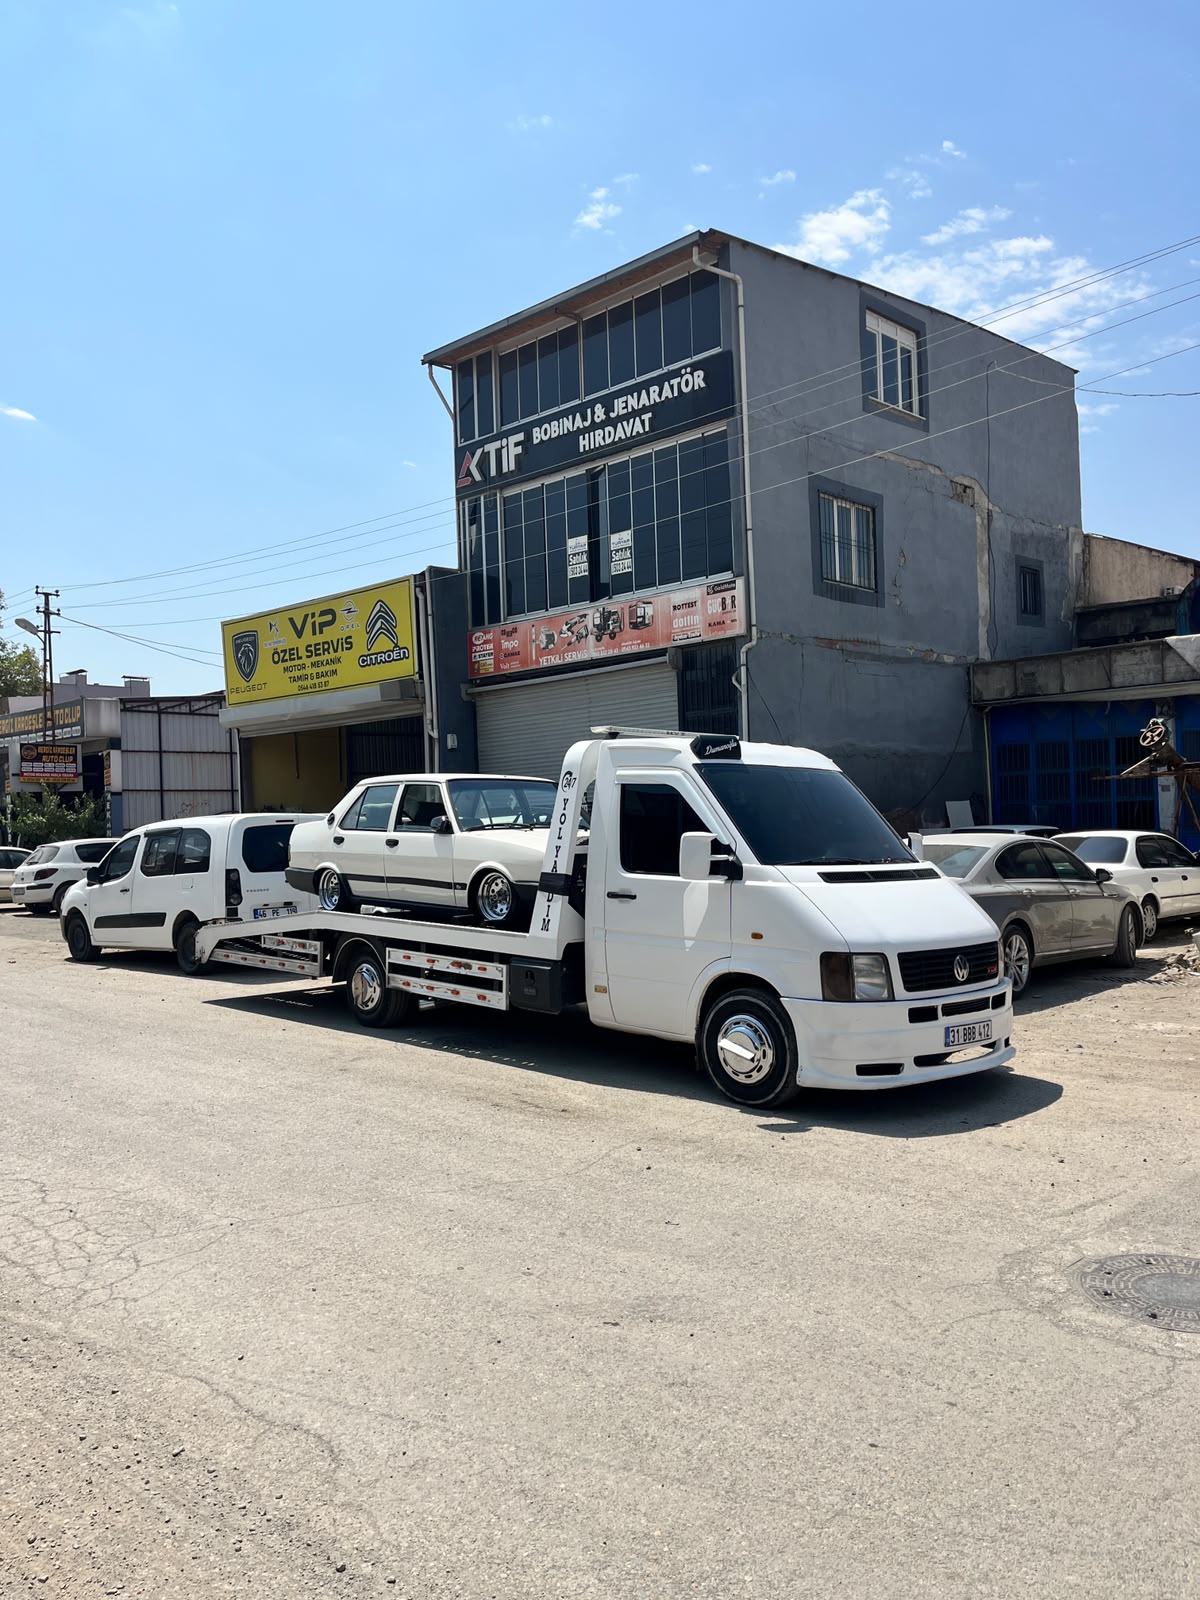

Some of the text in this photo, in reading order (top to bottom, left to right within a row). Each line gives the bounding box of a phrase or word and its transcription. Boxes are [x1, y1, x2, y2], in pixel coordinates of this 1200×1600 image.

[593, 403, 606, 424] &
[609, 367, 705, 418] JENARATÖR
[579, 412, 652, 452] HIRDAVAT
[672, 601, 697, 611] ROTTEST
[340, 623, 360, 632] OPEL
[272, 647, 302, 665] ÖZEL
[305, 635, 353, 659] SERVİS
[283, 664, 306, 675] MOTOR
[311, 655, 342, 669] MEKANİK
[288, 673, 309, 684] TAMİR
[316, 668, 338, 680] BAKIM
[230, 682, 267, 695] PEUGEOT
[541, 798, 569, 932] YOL YADIM
[272, 909, 280, 917] PE
[950, 1023, 990, 1044] 31 BBB 412
